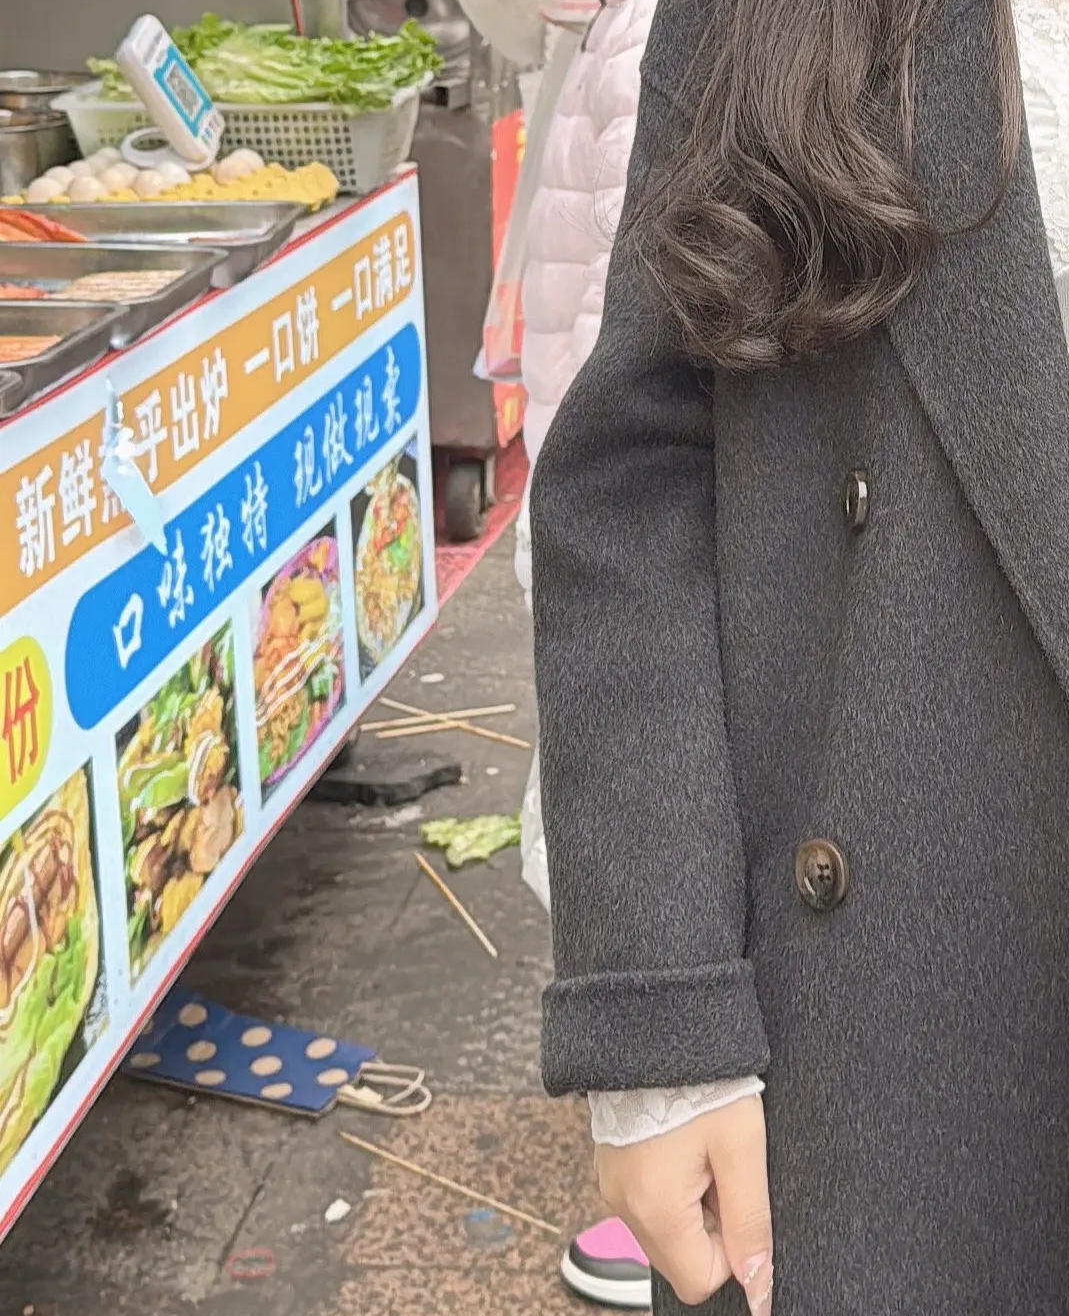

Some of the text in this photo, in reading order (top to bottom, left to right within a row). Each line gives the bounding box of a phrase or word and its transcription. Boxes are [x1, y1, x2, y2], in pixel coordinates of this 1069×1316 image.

[15, 223, 412, 579] 新鲜乎出炉 一口饼 一口满足
[113, 345, 402, 670] 口味独特 现做现卖
[3, 655, 40, 786] 份
